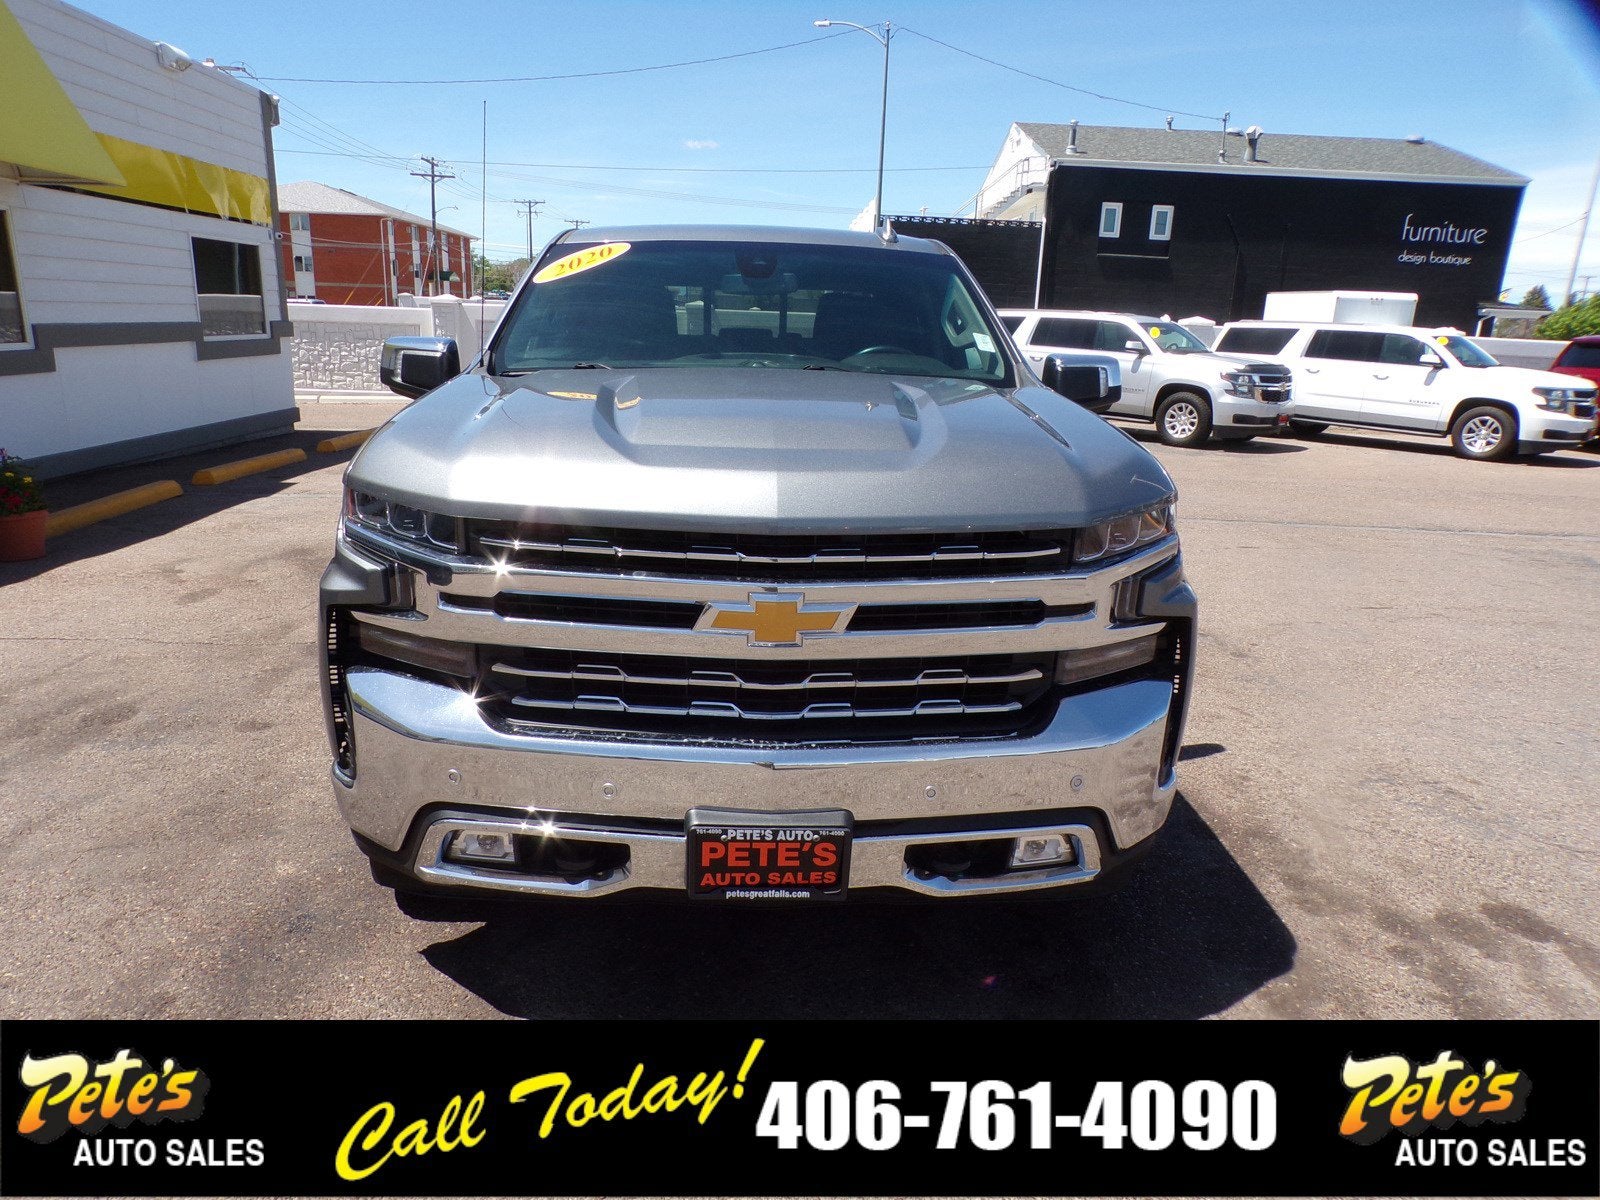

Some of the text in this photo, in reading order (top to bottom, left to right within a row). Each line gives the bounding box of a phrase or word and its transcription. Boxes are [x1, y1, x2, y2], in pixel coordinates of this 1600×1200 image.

[1402, 213, 1488, 244] furniture
[554, 246, 613, 276] 2020
[1397, 250, 1472, 266] design boutique
[727, 829, 814, 841] PETE'S AUTO
[702, 842, 837, 867] PETE'S
[700, 871, 836, 886] AUTO SALES
[725, 889, 811, 899] petesgreatfalls.com
